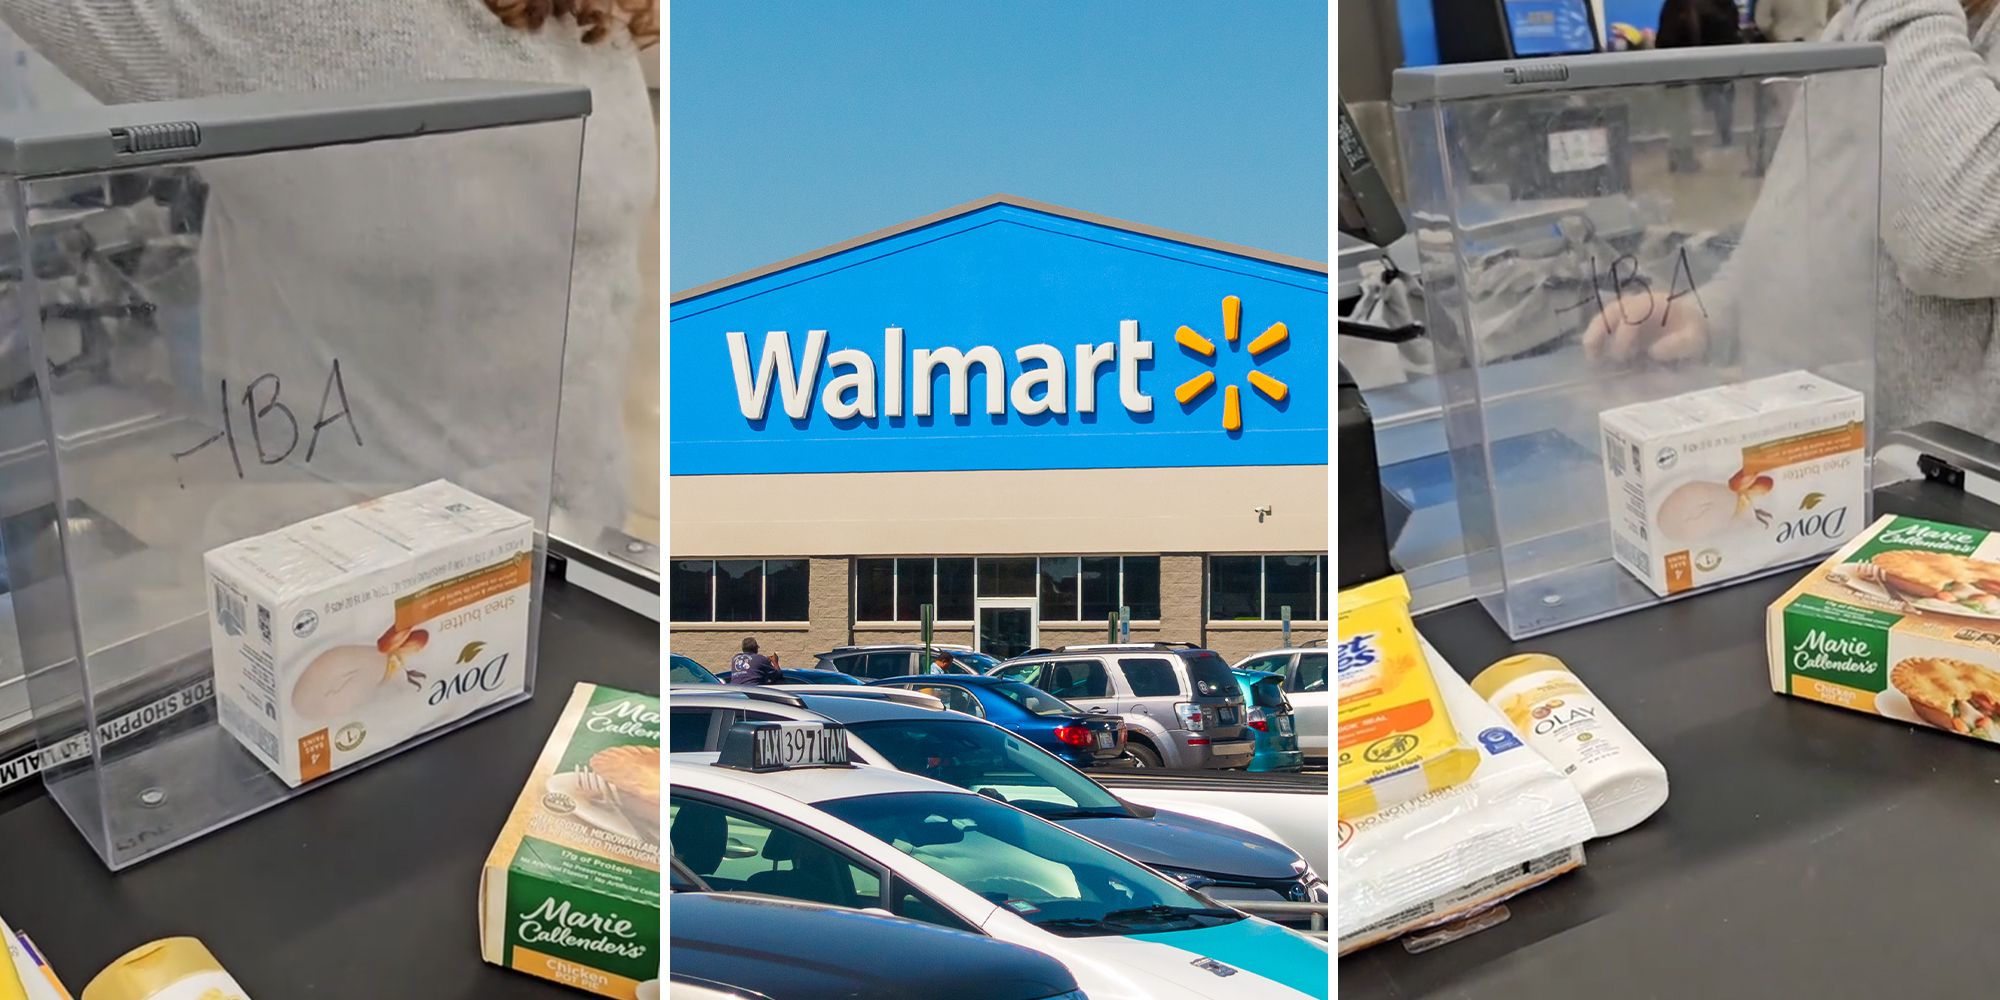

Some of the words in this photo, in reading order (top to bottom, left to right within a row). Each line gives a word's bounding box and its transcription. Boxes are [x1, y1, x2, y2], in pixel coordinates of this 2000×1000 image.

[726, 319, 1153, 420] Walmart
[1776, 507, 1847, 543] Dove
[1887, 524, 1974, 543] Marie
[485, 595, 516, 614] shea
[439, 610, 481, 632] butter
[1793, 629, 1871, 657] Marie
[1794, 651, 1877, 674] Callender's
[183, 679, 214, 706] FOR
[428, 653, 510, 706] Dove
[1814, 682, 1856, 699] Chicken
[98, 700, 178, 744] SHOPPIN
[1535, 707, 1597, 735] OLAY
[311, 753, 320, 765] 4
[757, 729, 783, 765] TAXI
[785, 729, 825, 763] 3971
[824, 729, 847, 762] TAXI
[1355, 816, 1377, 831] DO
[1378, 801, 1407, 819] NOT
[1409, 785, 1453, 805] FLUSH
[561, 850, 577, 862] 17g
[580, 856, 592, 864] of
[593, 859, 633, 875] Protein
[574, 863, 623, 882] Preservatives
[563, 867, 589, 880] Flavors
[595, 877, 606, 885] No
[607, 880, 639, 894] Artificial
[520, 897, 637, 938] Marie
[518, 921, 646, 958] Callender's
[546, 959, 609, 985] Chicken
[555, 971, 577, 985] POT
[582, 976, 599, 990] PIE
